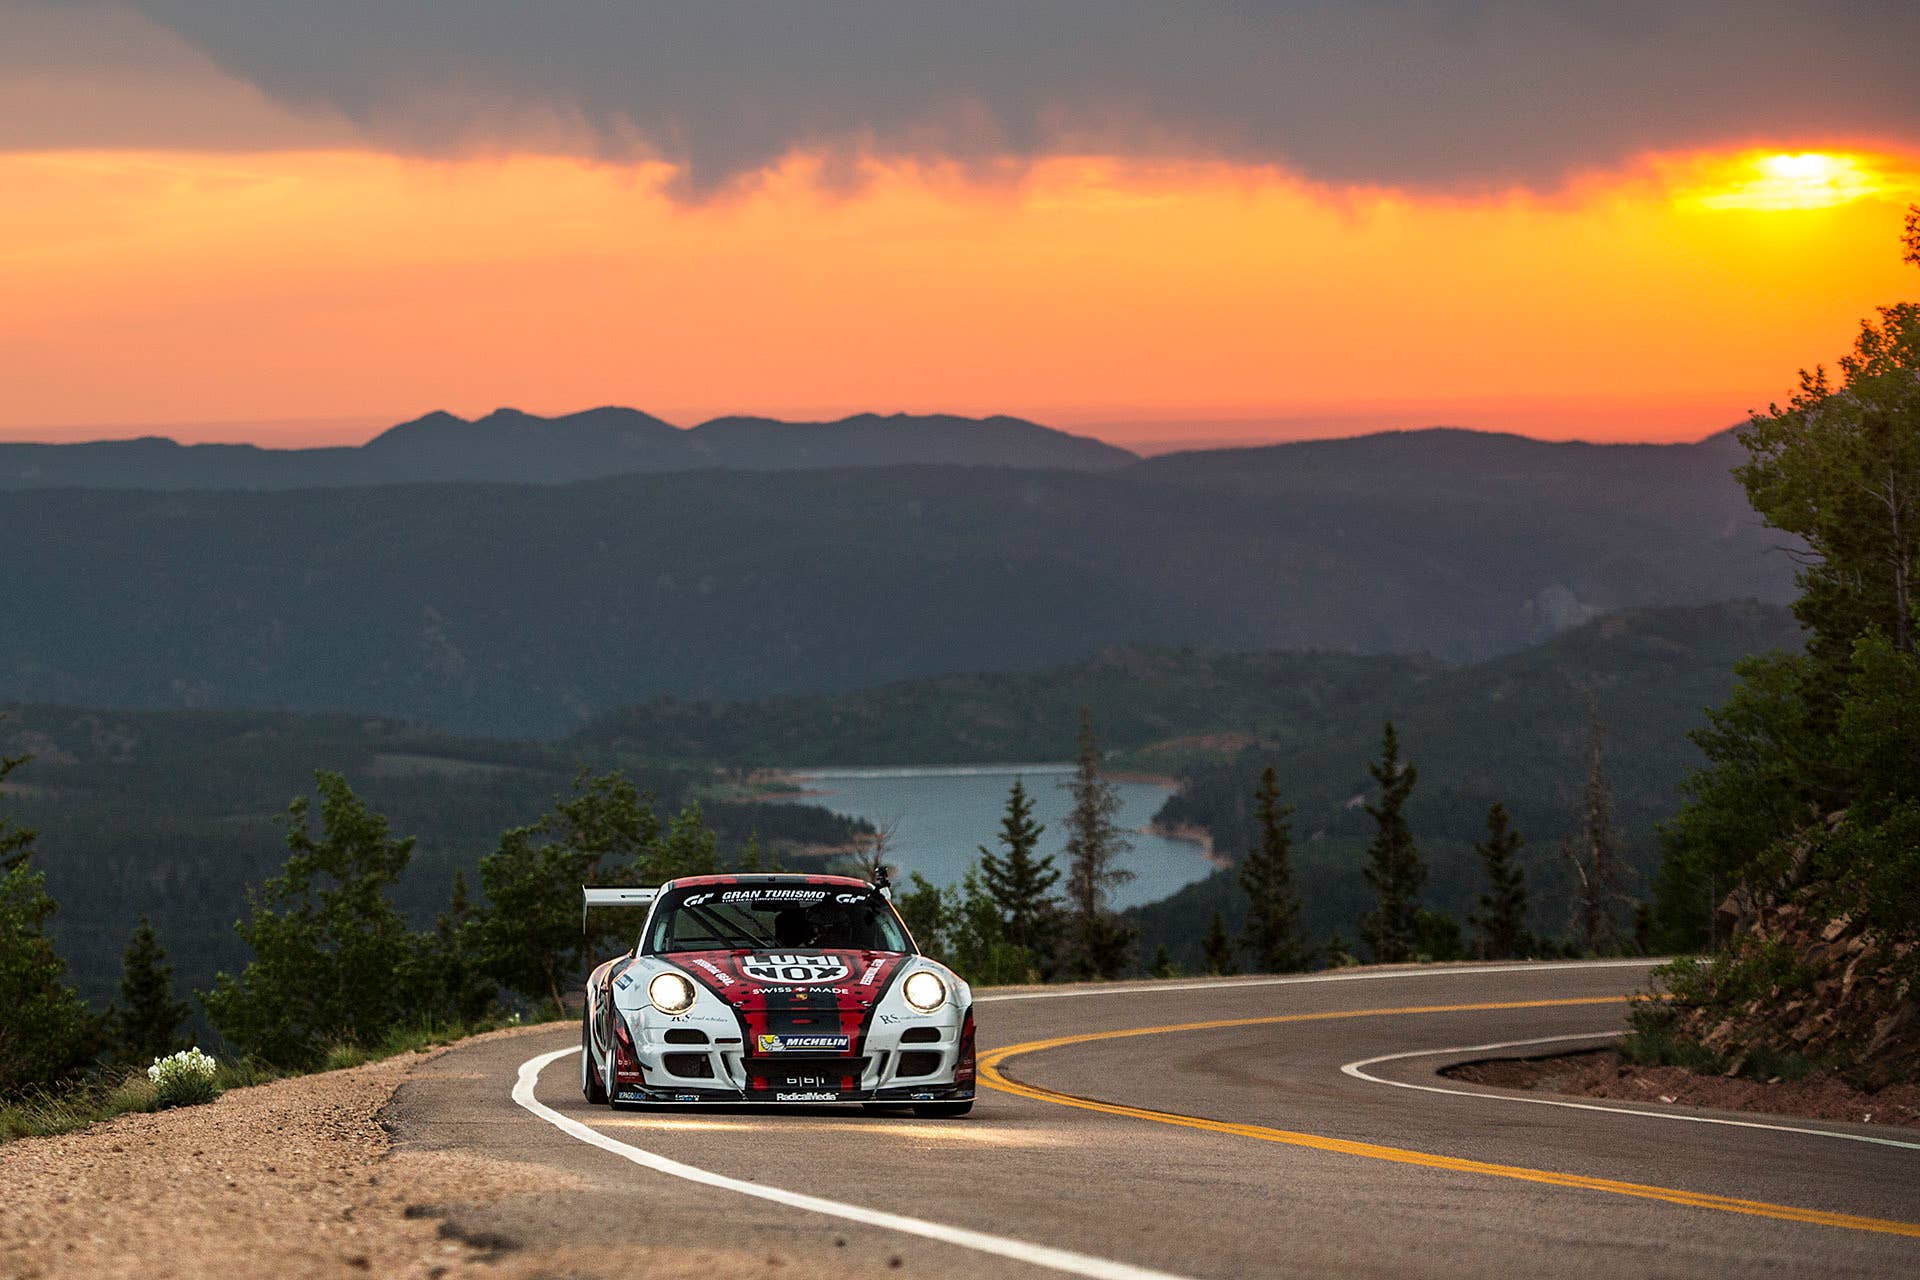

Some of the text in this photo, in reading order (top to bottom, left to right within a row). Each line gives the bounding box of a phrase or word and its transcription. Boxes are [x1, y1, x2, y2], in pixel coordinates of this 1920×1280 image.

[722, 890, 826, 899] GRAN TURISMO
[744, 955, 840, 966] LUMI
[749, 967, 842, 981] NOX
[752, 986, 849, 995] SWISS MADE
[880, 1013, 900, 1024] RS
[786, 1038, 848, 1046] MICHELIN
